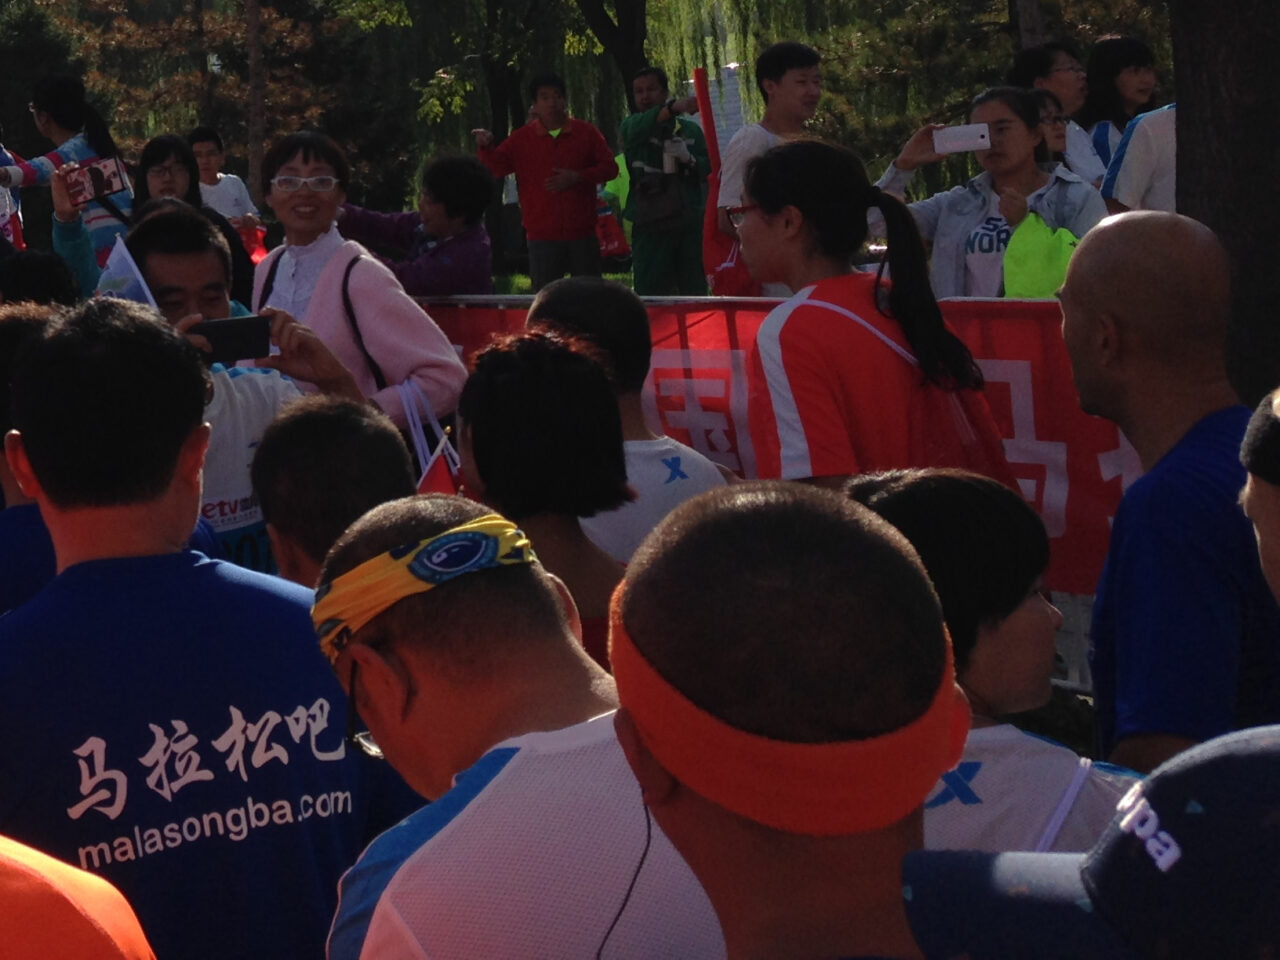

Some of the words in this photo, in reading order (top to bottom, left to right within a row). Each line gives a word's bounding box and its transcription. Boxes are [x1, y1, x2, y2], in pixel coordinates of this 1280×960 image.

[66, 696, 346, 822] 马拉松吧
[77, 787, 353, 871] malasongba.com
